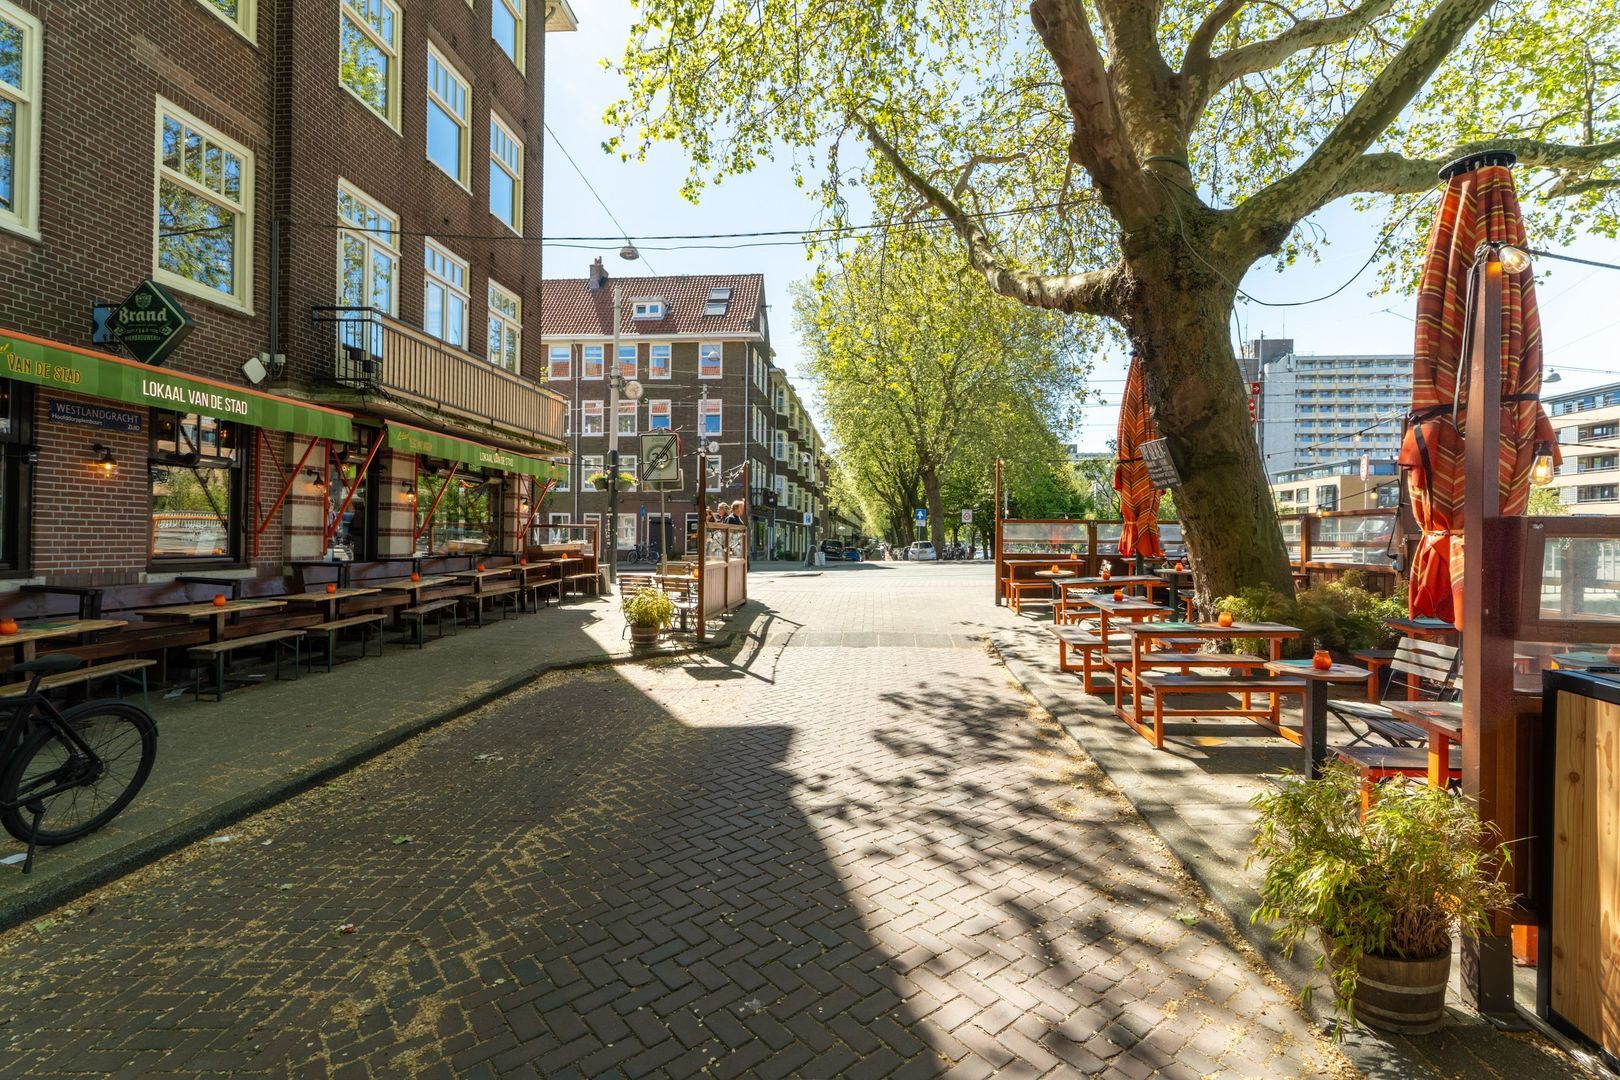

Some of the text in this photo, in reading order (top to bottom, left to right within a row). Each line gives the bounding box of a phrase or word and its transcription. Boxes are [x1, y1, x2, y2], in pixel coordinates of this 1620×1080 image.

[119, 307, 168, 324] Brand
[7, 352, 82, 384] VAN DE STAD
[143, 380, 248, 415] LOKAAL VAN DE STAD
[56, 402, 139, 424] WESTLANDGRACHT
